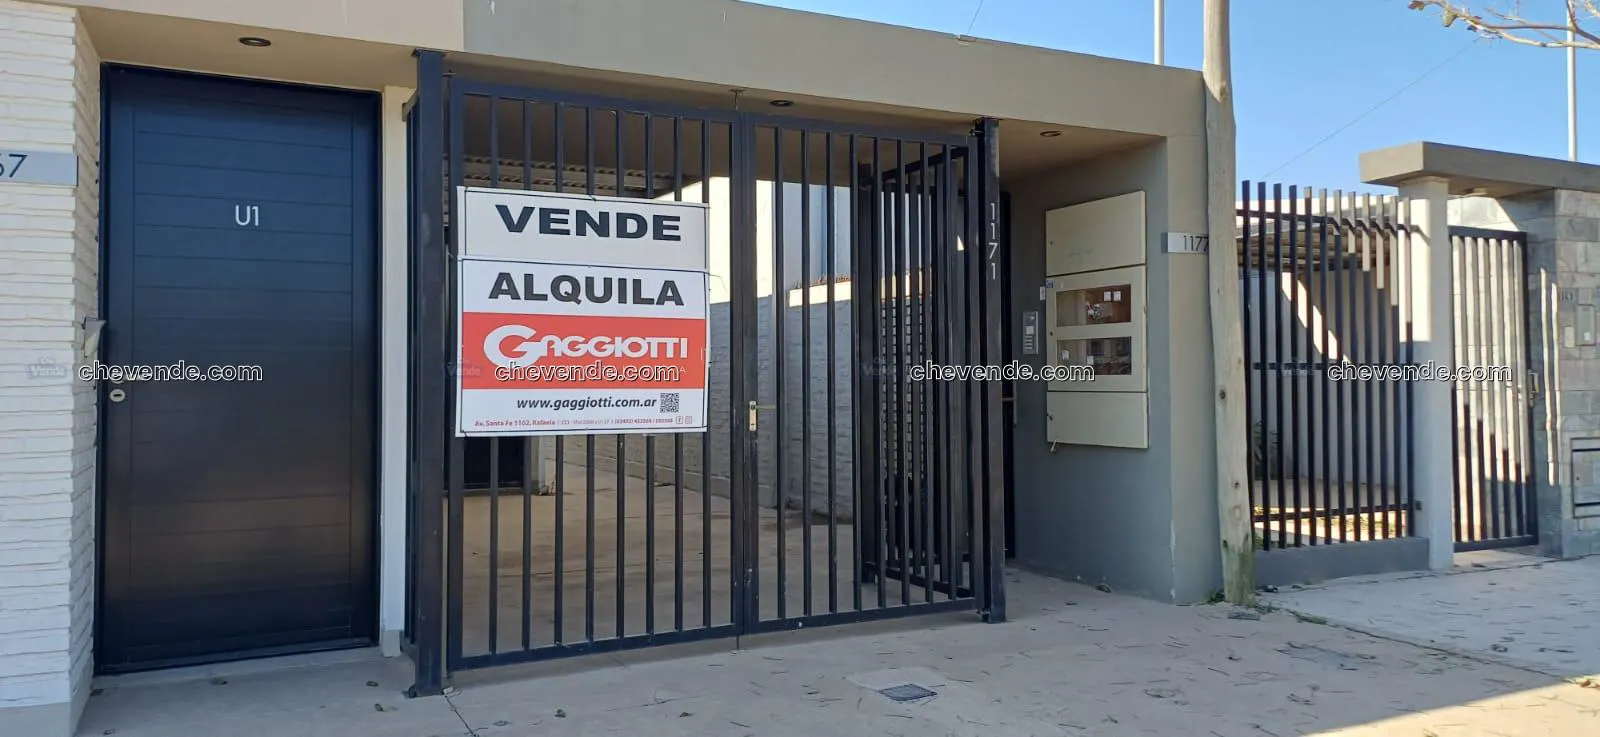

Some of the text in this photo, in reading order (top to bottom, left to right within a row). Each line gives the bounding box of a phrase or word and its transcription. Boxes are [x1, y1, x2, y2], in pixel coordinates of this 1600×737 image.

[235, 204, 259, 226] U1
[495, 204, 681, 241] VENDE
[988, 202, 999, 280] 1171
[488, 271, 684, 305] ALQUILA
[516, 396, 657, 411] www.gaggiotti.com.ar
